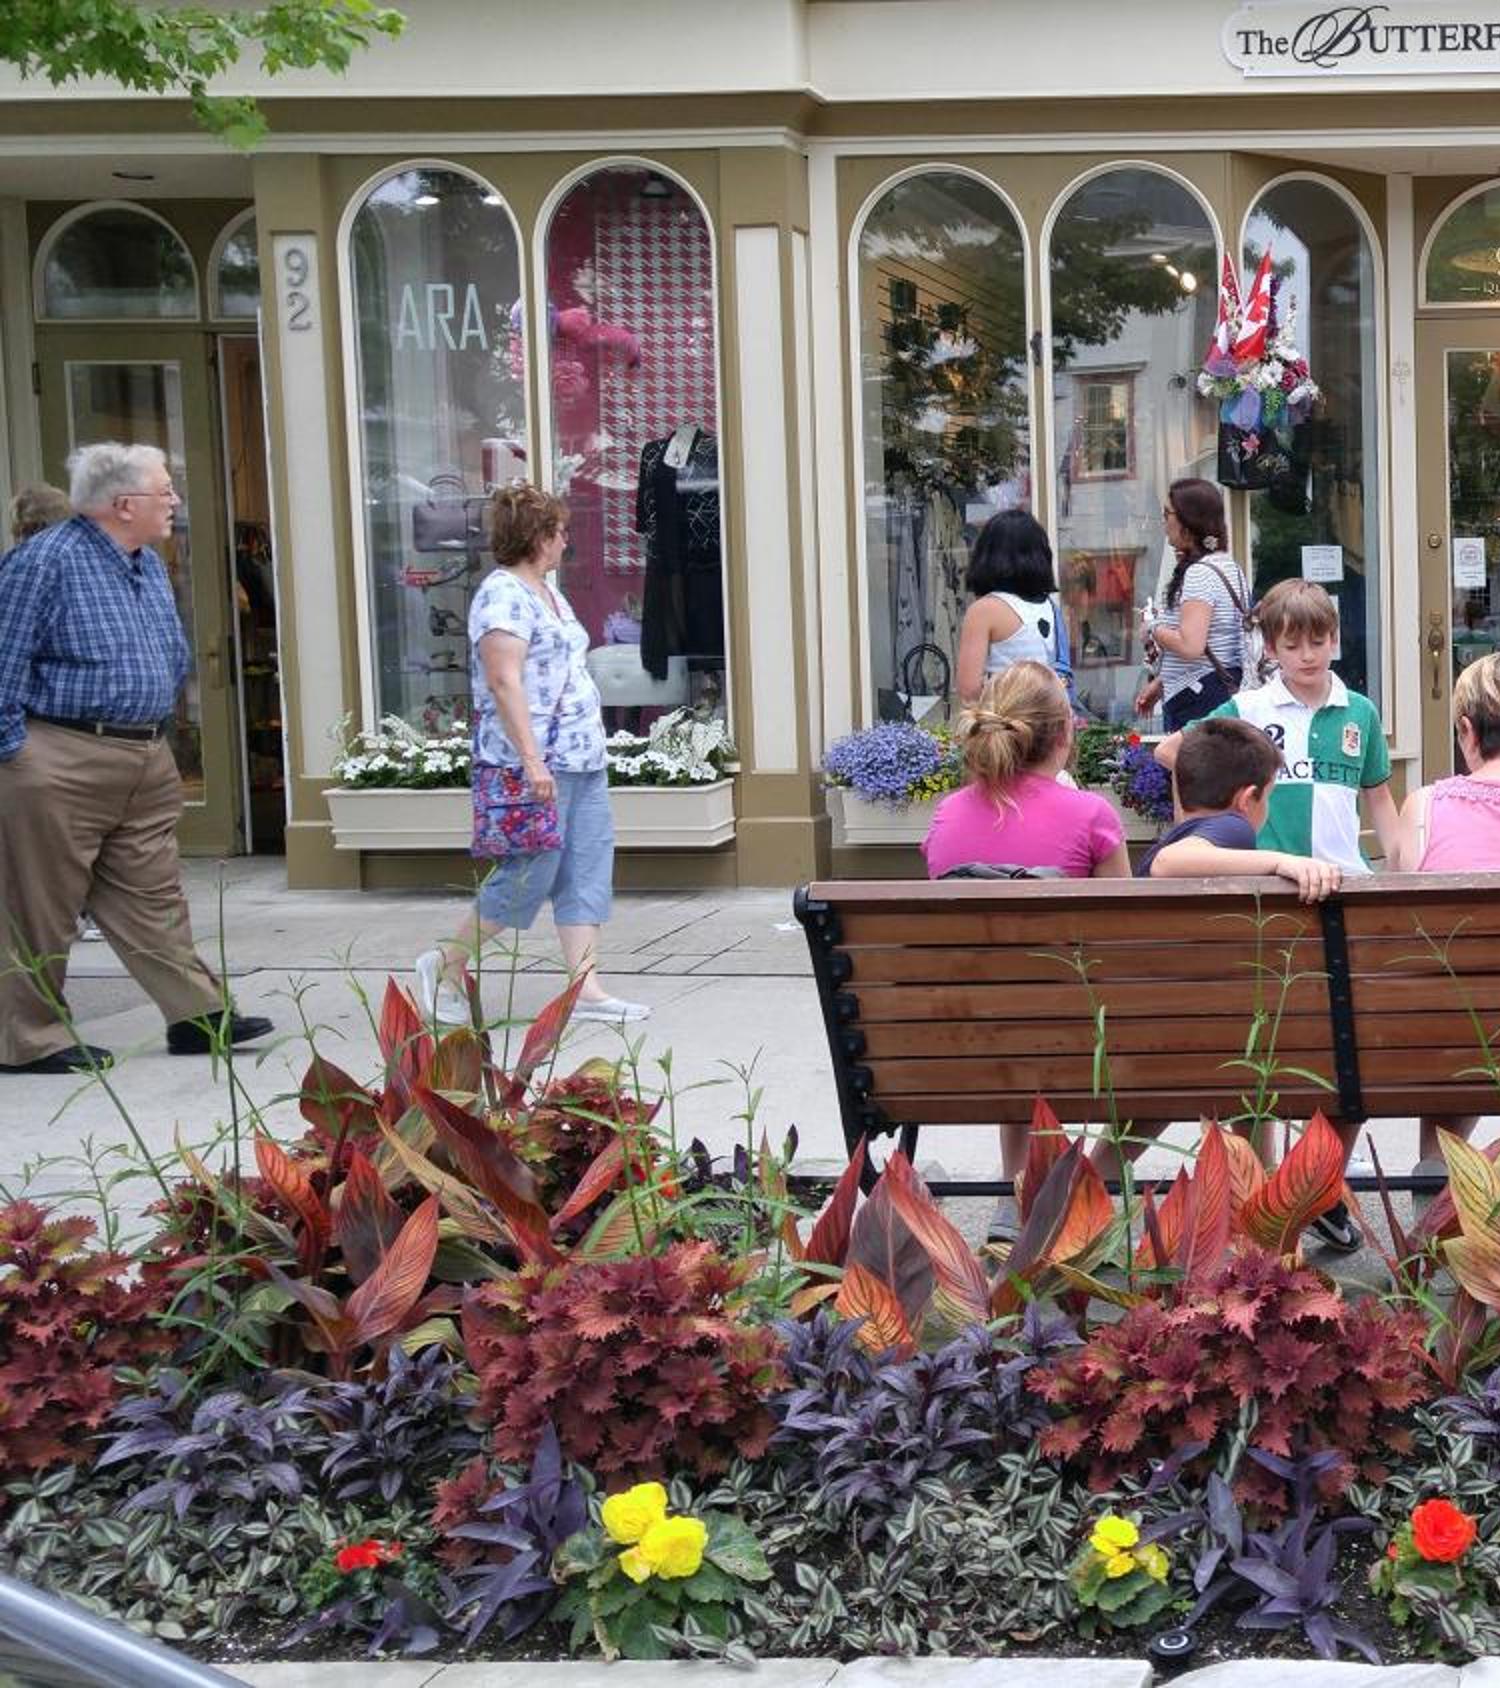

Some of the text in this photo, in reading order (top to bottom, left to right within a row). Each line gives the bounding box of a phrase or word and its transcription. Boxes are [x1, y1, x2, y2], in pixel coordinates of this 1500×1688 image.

[1236, 31, 1289, 55] The
[397, 283, 488, 350] ARA
[1278, 760, 1360, 784] ACKETT
